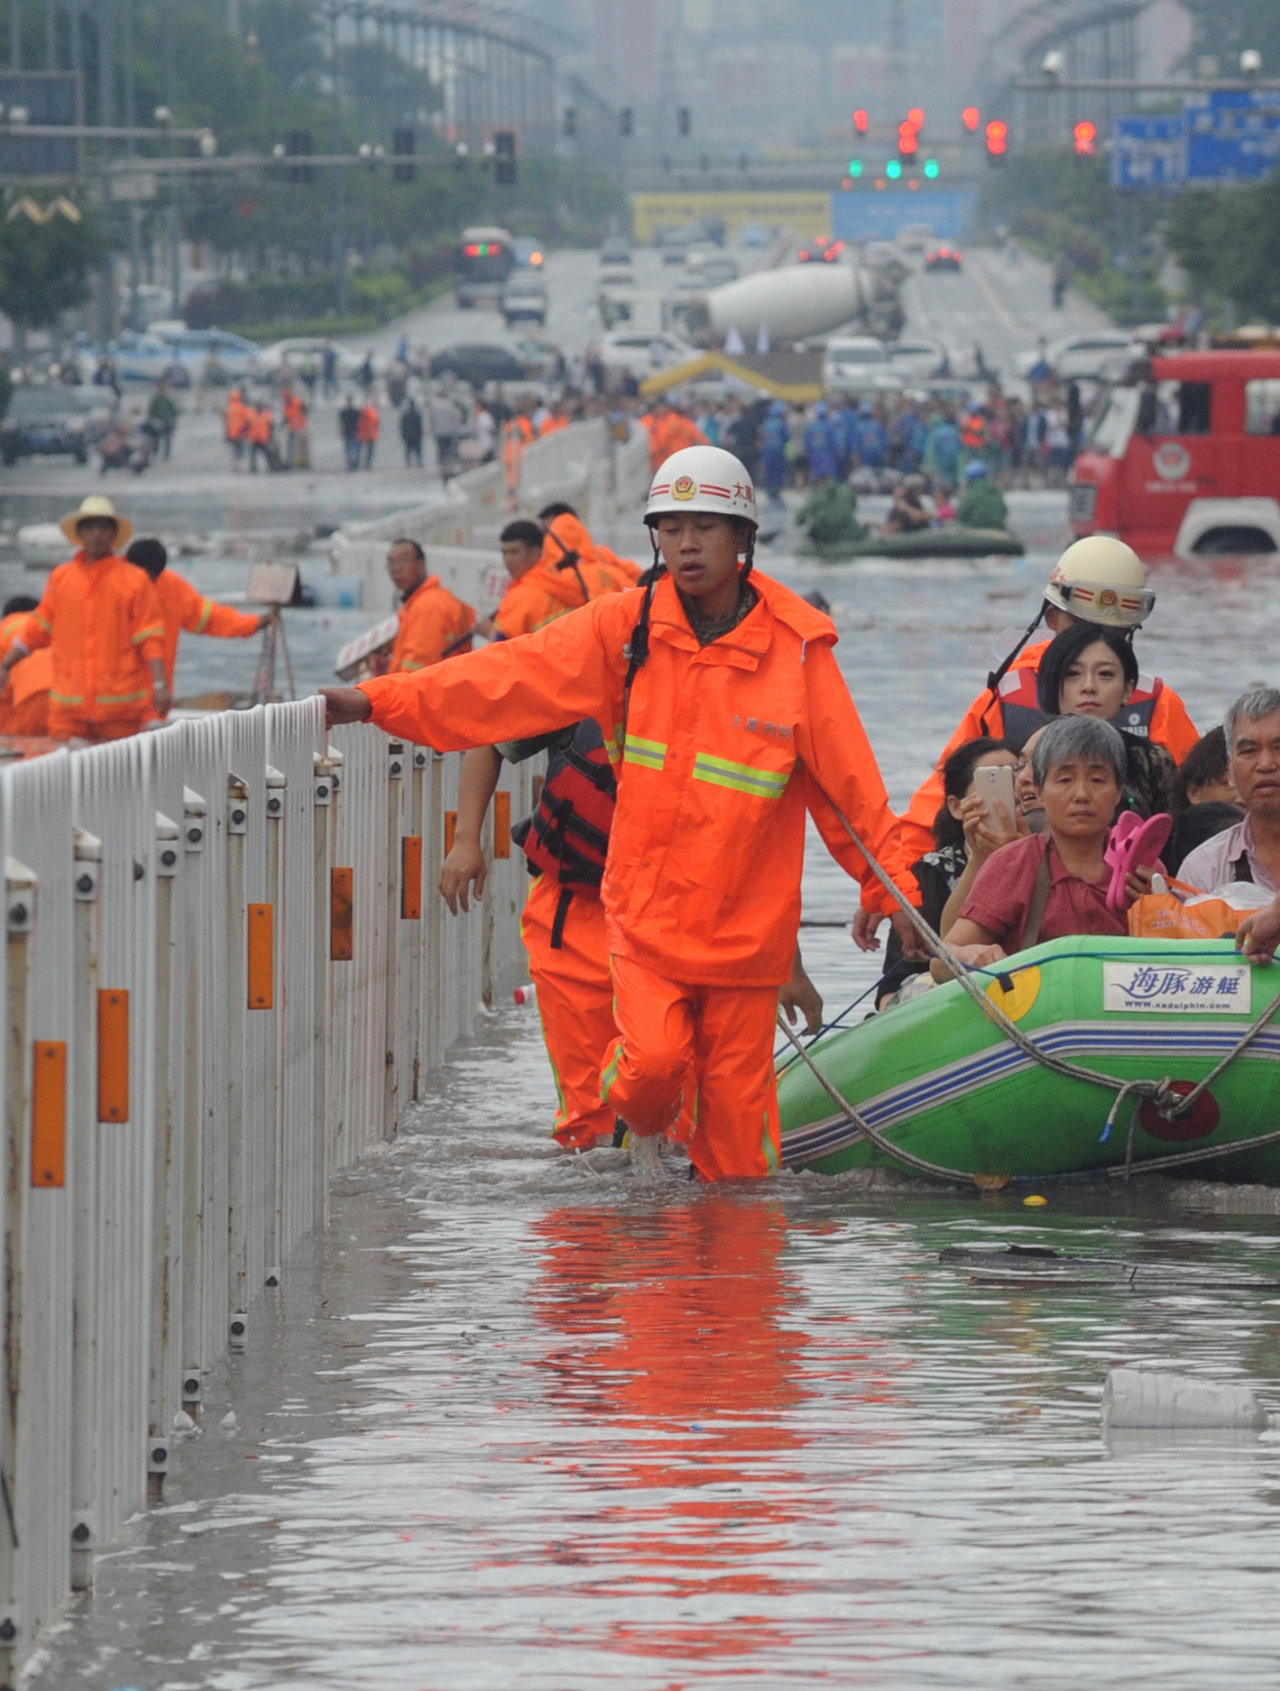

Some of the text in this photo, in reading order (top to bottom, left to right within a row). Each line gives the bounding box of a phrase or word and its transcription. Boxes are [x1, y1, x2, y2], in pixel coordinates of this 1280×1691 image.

[1128, 967, 1241, 996] 海豚游艇
[1125, 1000, 1231, 1011] www.xadolphin.com
